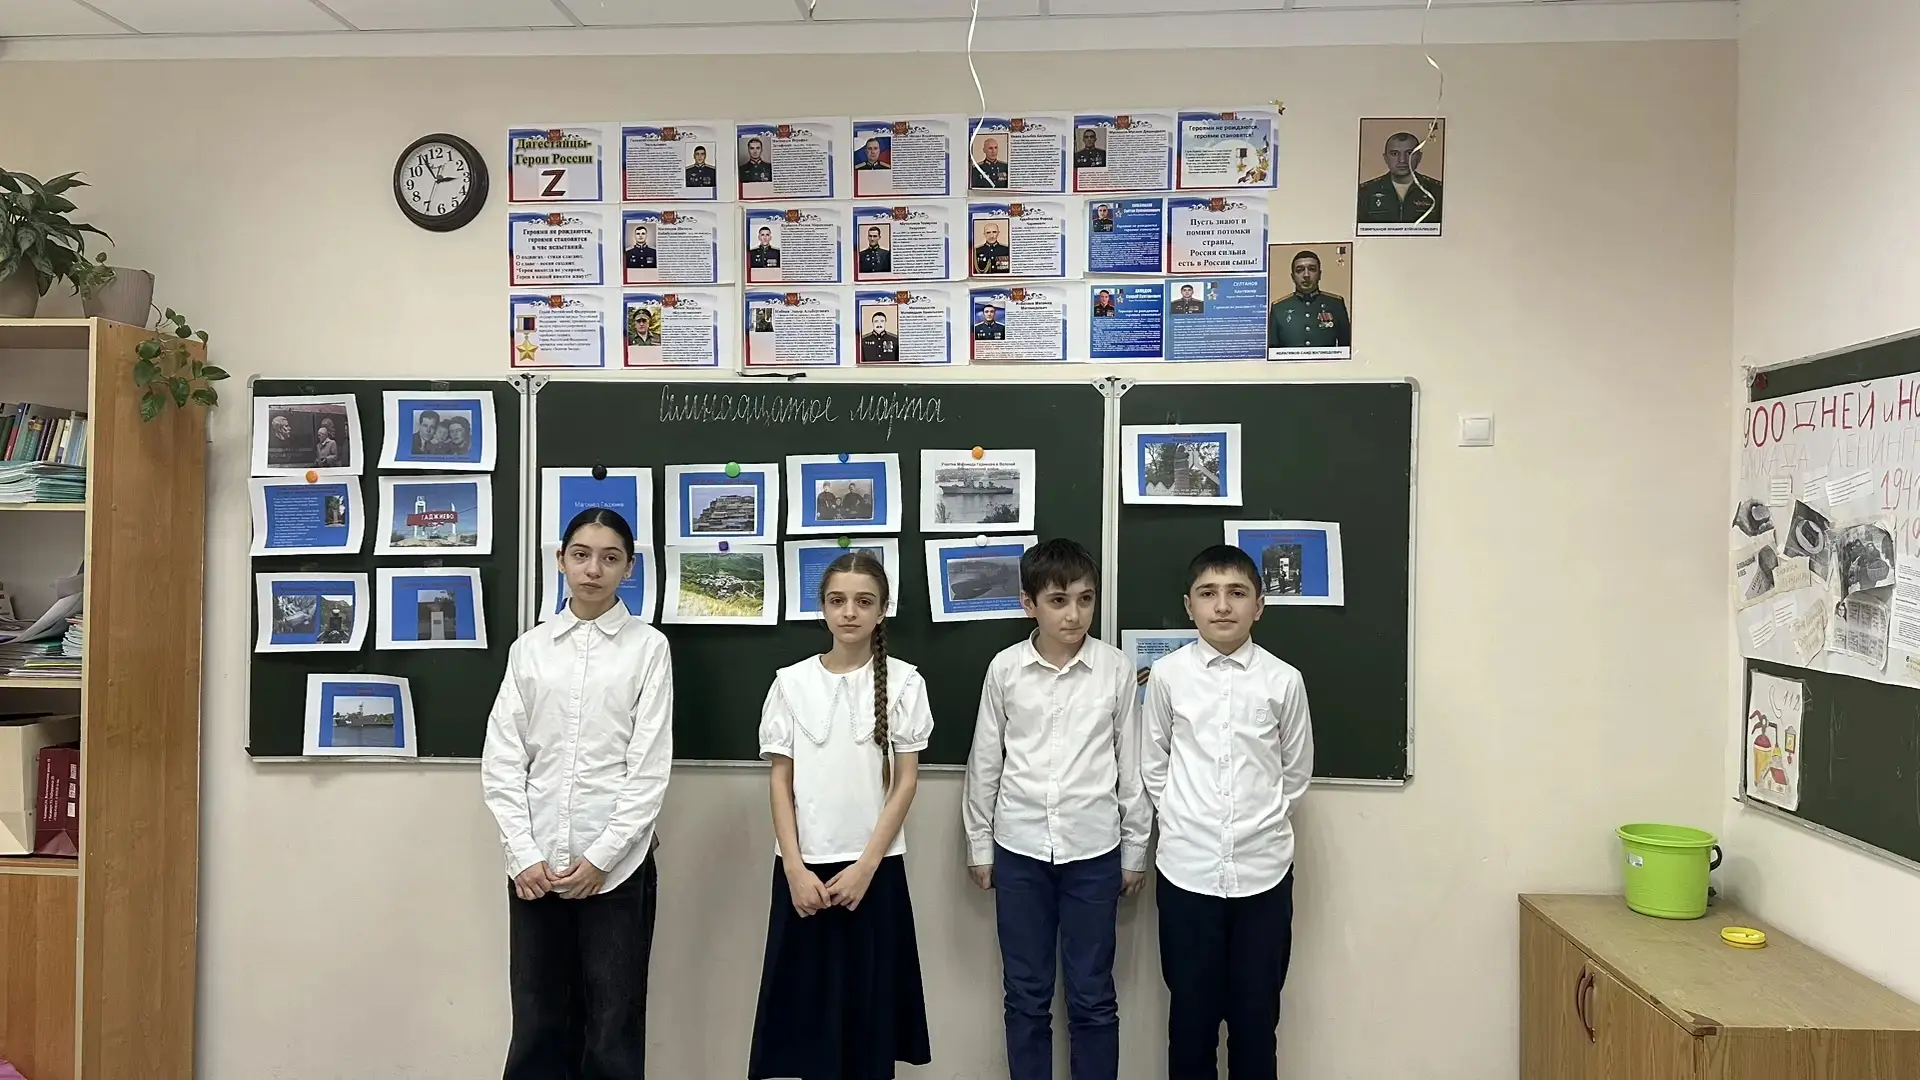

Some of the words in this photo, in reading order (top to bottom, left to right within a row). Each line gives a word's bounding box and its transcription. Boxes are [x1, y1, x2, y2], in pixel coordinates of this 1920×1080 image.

[428, 148, 443, 159] 12
[447, 151, 453, 161] 1
[456, 160, 464, 171] 2
[515, 154, 549, 167] Герои
[552, 154, 593, 164] России
[409, 166, 423, 178] 10
[463, 172, 470, 183] 3
[406, 179, 414, 190] 9
[541, 170, 566, 196] Z
[459, 185, 467, 196] 4
[412, 191, 421, 202] 8
[451, 196, 459, 207] 5
[423, 201, 430, 212] 7
[437, 203, 446, 214] 6
[850, 391, 945, 441] марта
[1743, 401, 1786, 448] 900
[1793, 382, 1875, 434] ДНЕЙ
[1883, 401, 1894, 423] и
